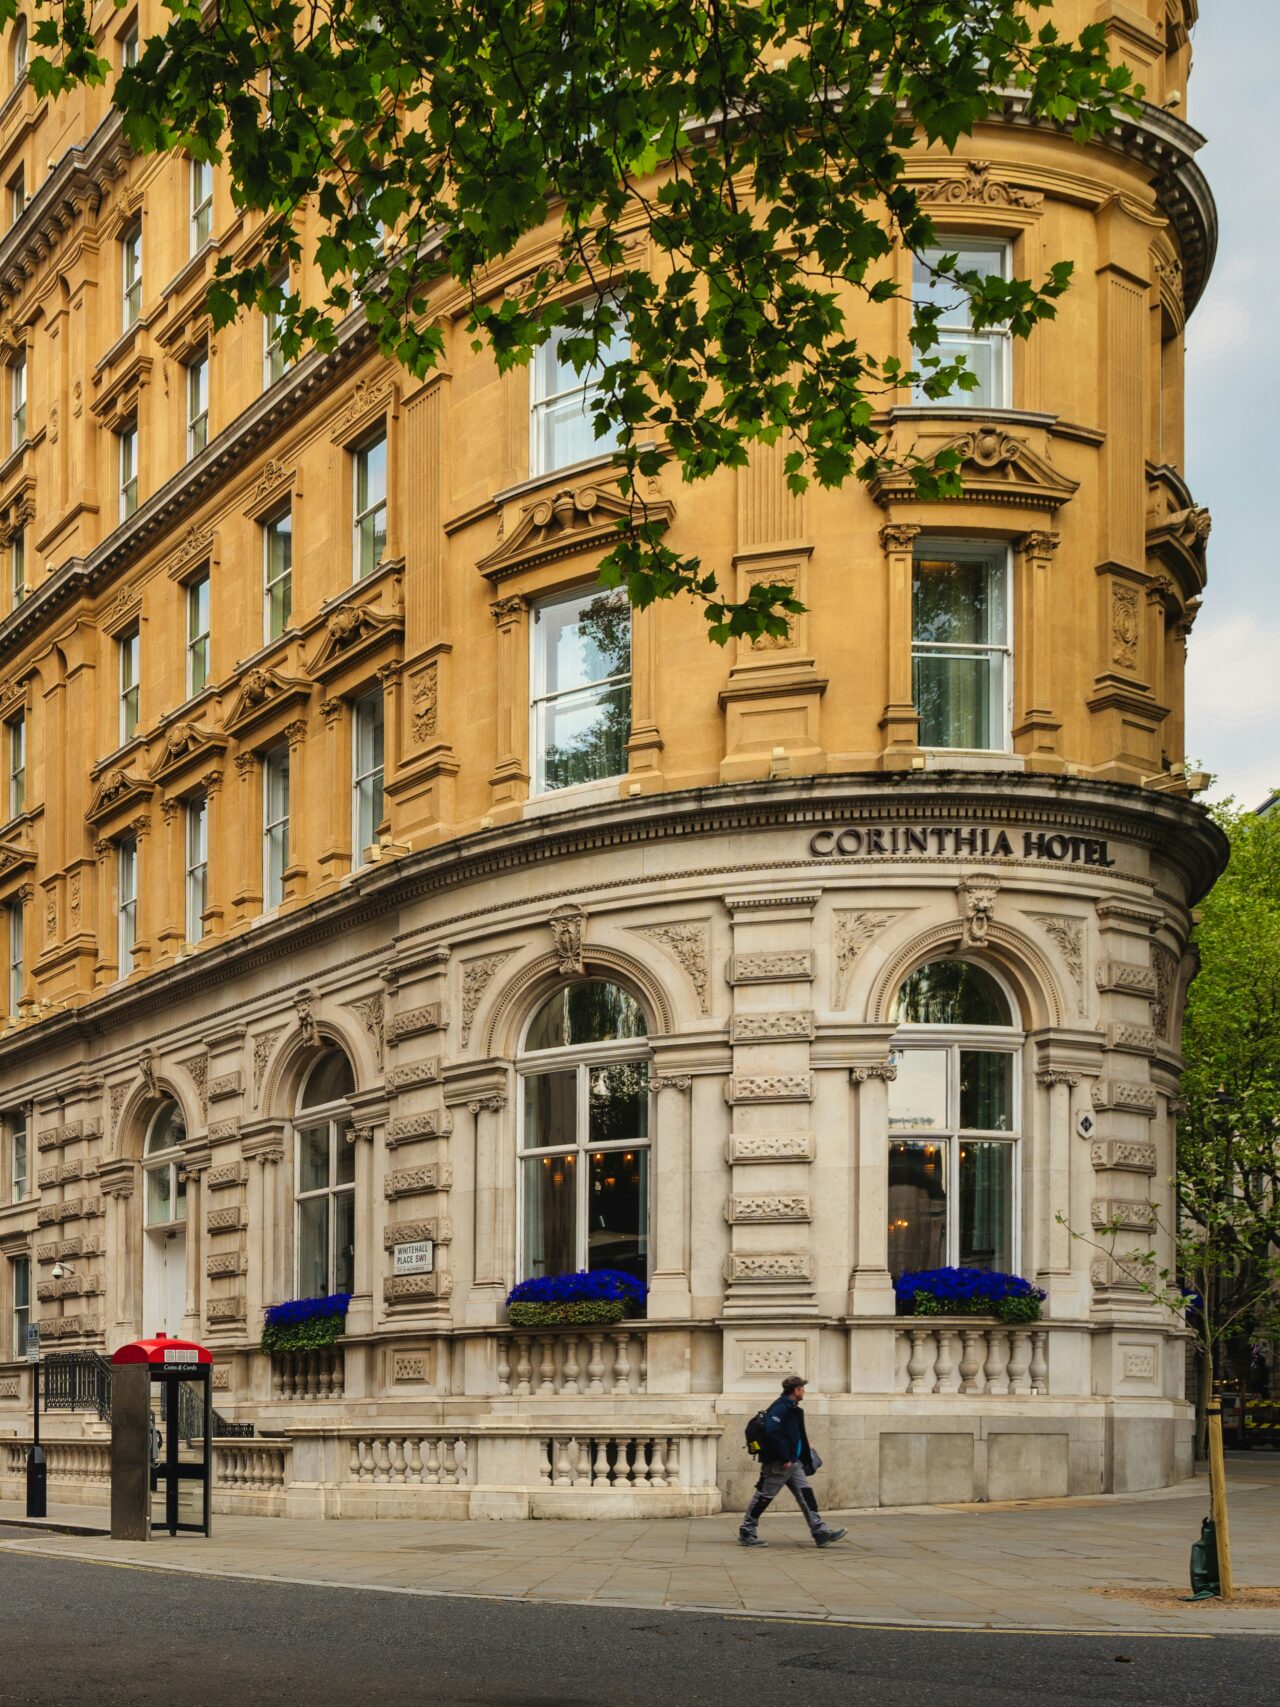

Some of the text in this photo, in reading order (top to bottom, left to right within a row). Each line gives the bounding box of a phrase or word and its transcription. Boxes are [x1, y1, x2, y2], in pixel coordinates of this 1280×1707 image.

[809, 826, 1115, 867] CORINTHIA HOTEL
[397, 1244, 428, 1255] WHITEHALL
[397, 1255, 427, 1265] PLACE SW1
